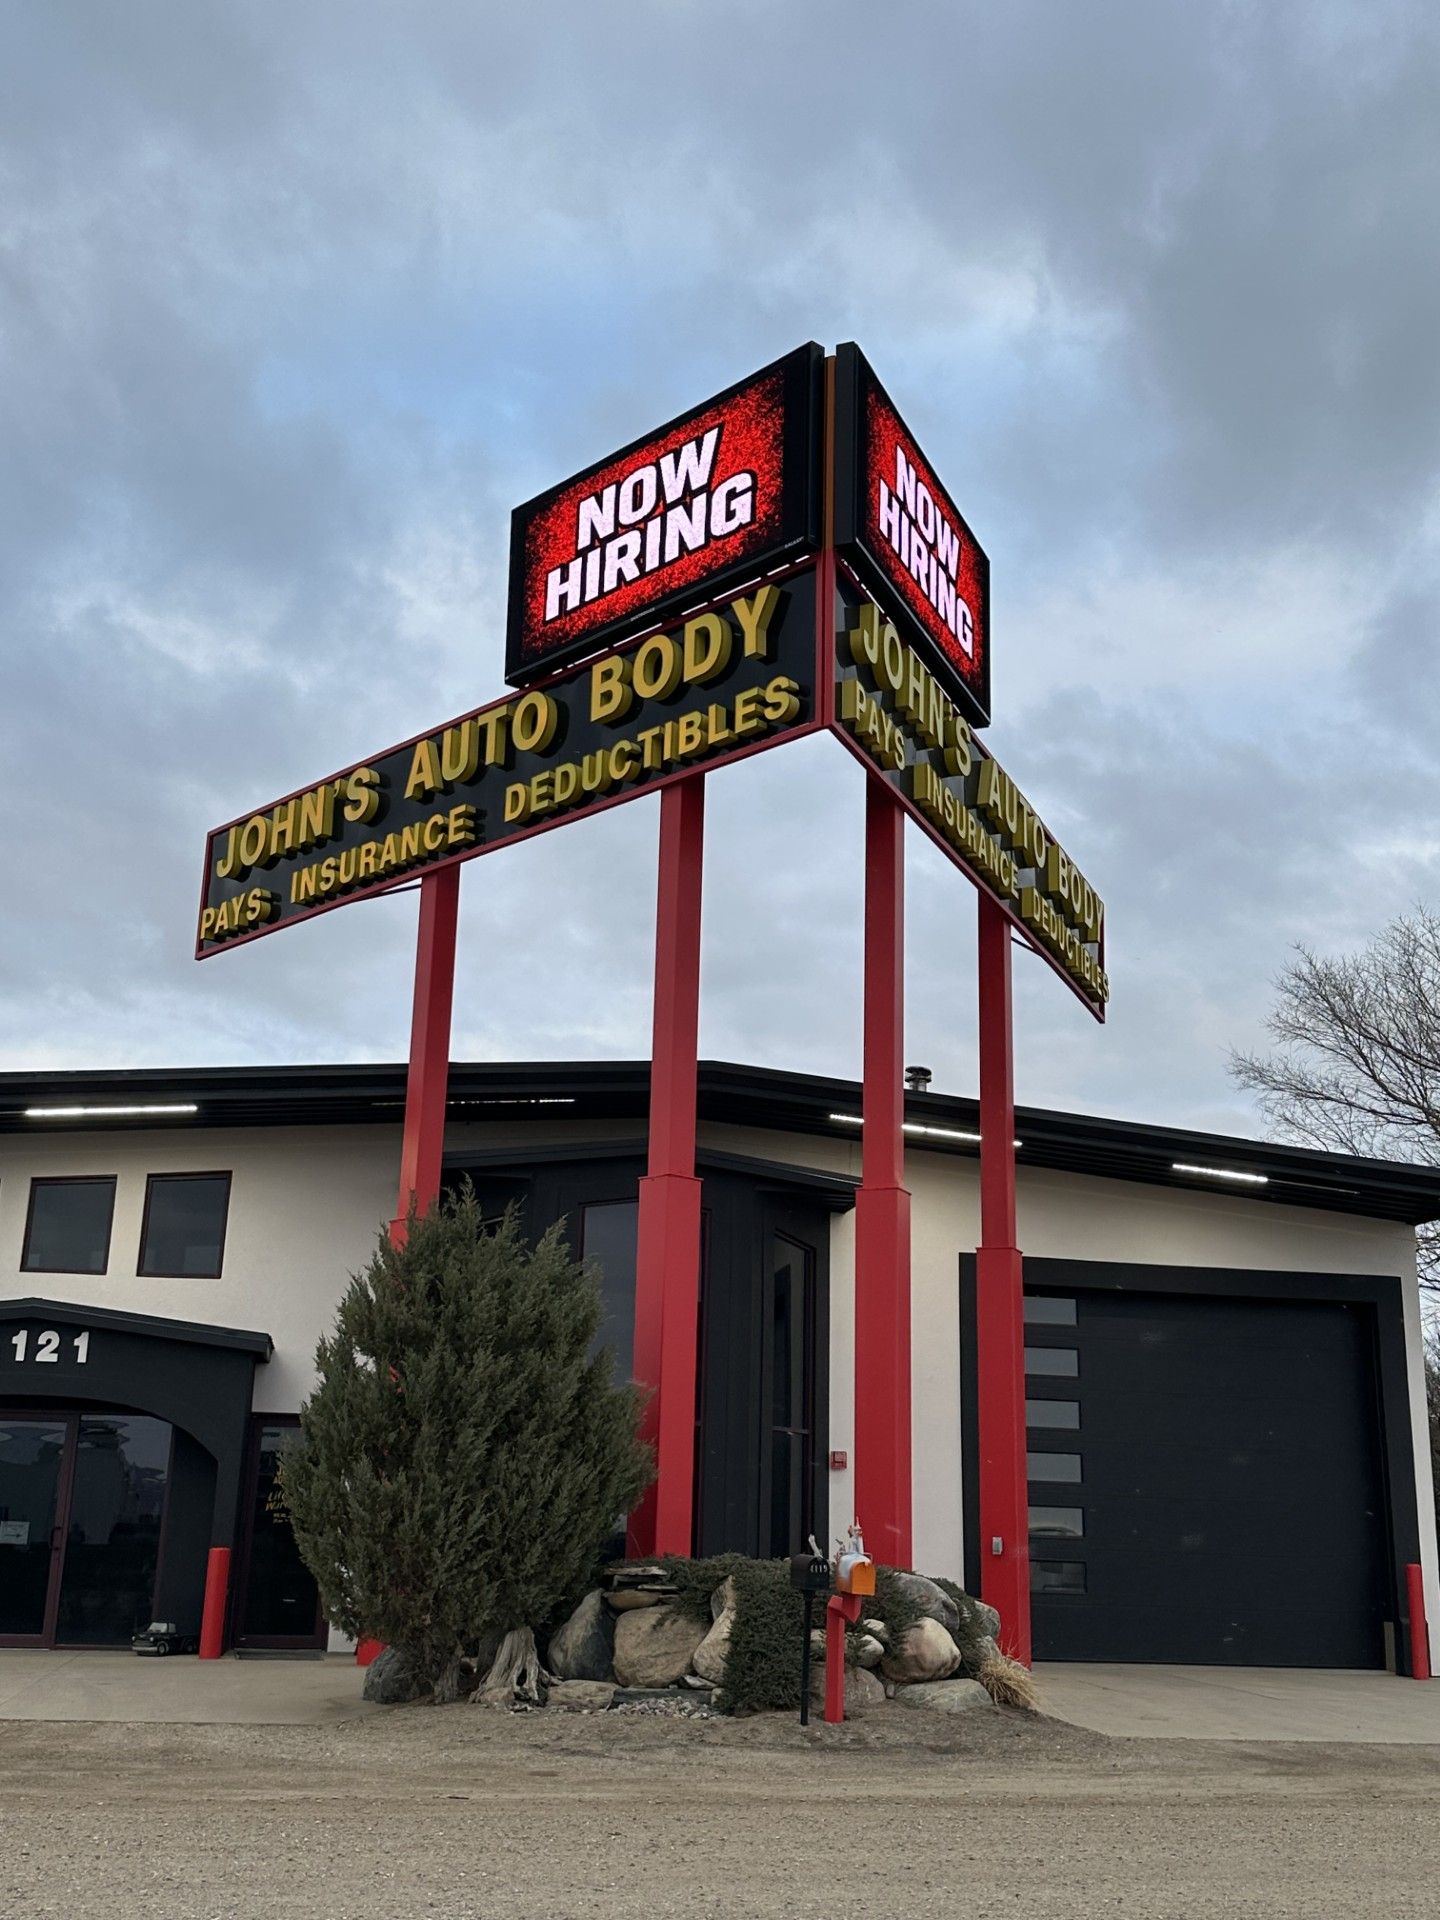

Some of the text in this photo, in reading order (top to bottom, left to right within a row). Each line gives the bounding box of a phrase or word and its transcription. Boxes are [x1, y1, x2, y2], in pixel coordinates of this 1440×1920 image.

[544, 473, 754, 622] HIRING
[577, 426, 720, 551] NOW
[879, 478, 973, 660] HIRING
[896, 444, 960, 582] NOW
[200, 676, 800, 941] PAYS INSURANCE DEDUCTIBLES
[215, 584, 783, 878] JOHN'S AUTO BODY
[851, 603, 1105, 943] JOHN'S AUTO BODY
[842, 680, 1109, 1003] PAYS INSURANCE DEDUCTIBLES
[11, 1329, 90, 1364] 121
